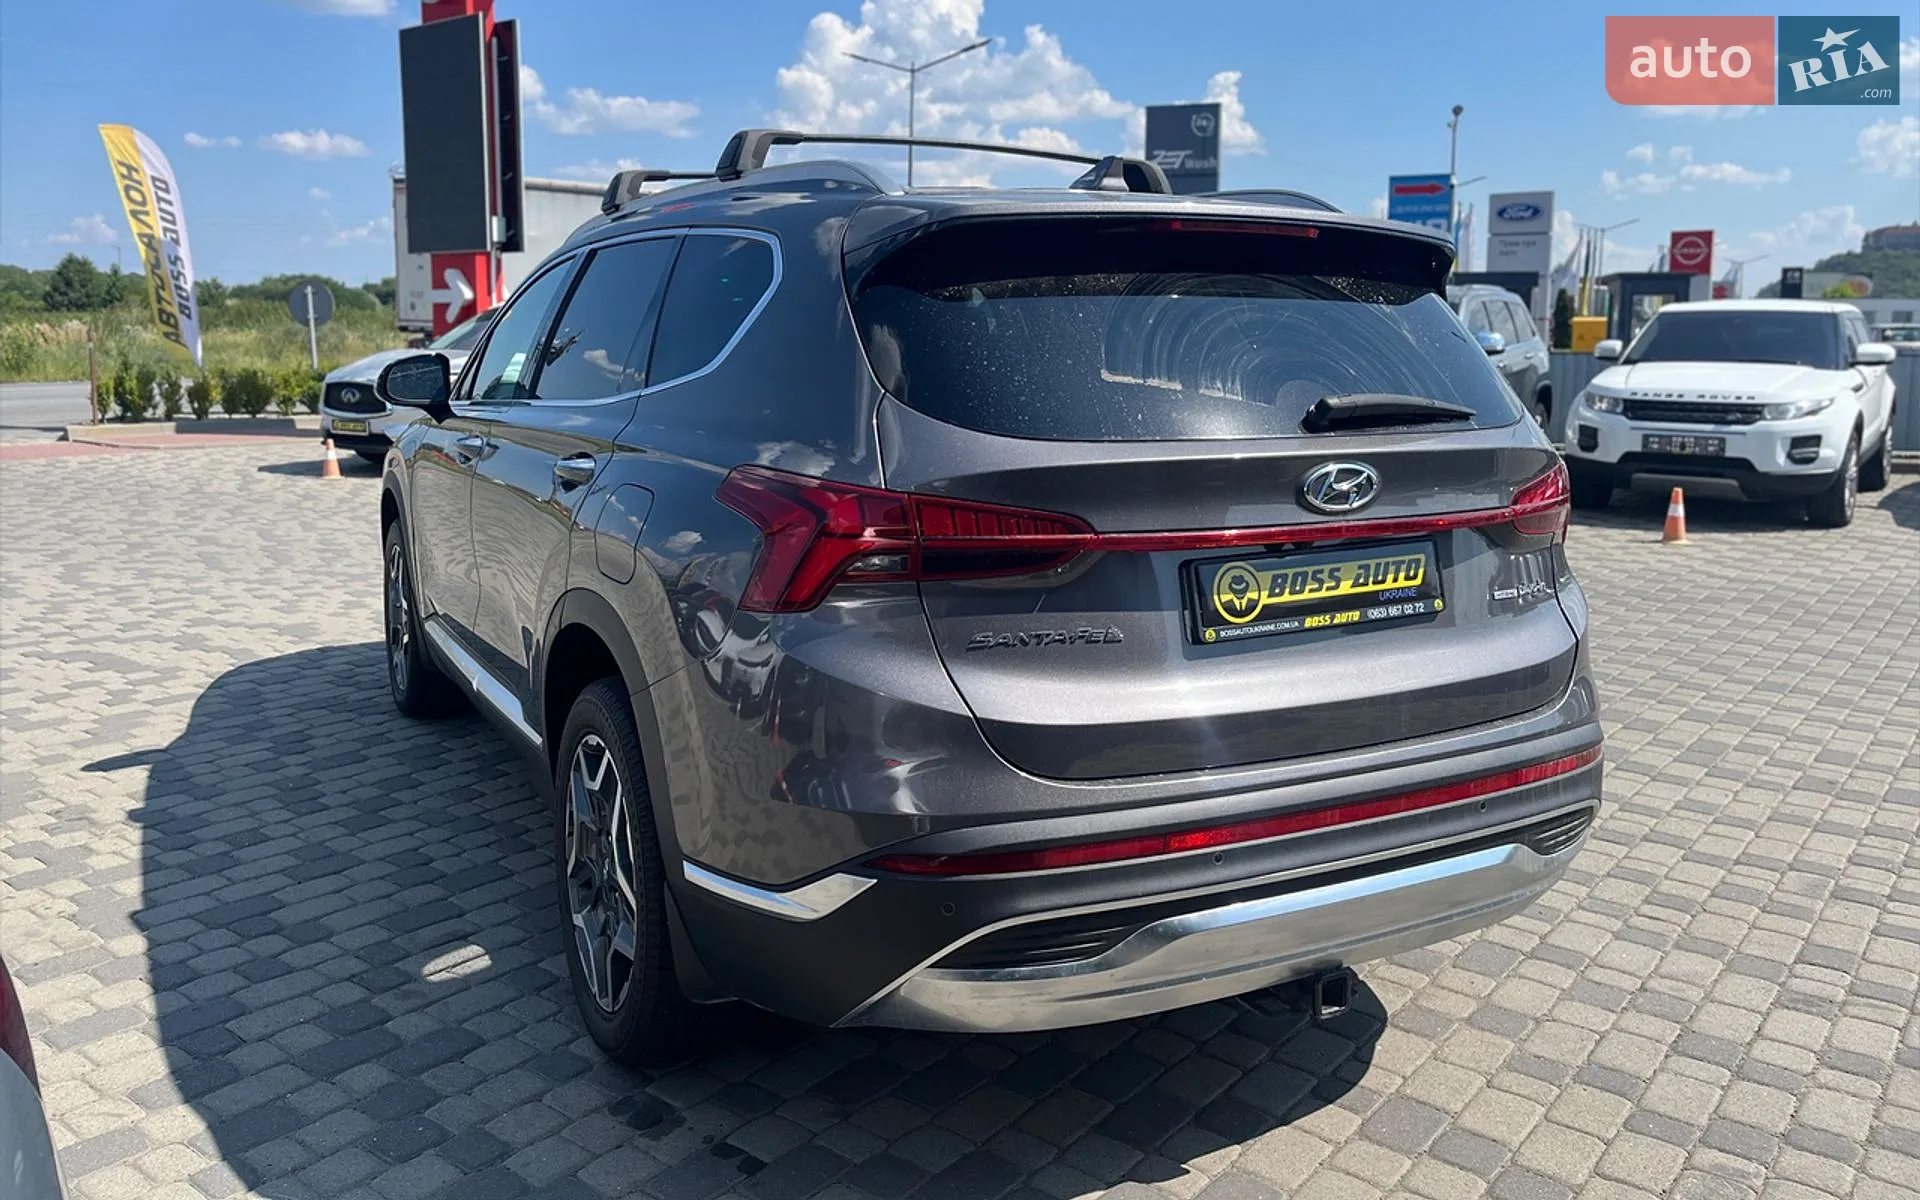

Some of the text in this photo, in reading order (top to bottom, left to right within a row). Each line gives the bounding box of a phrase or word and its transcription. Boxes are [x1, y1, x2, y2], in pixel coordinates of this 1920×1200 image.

[117, 160, 189, 349] АВТОСАЛОН
[150, 175, 194, 321] BOSS AUTO
[1630, 391, 1756, 401] RANGE ROVER
[1267, 557, 1422, 599] BOSS AUTO
[1378, 586, 1418, 601] UKRAINE
[1415, 602, 1425, 613] 72
[1304, 610, 1361, 628] BOSS AUTO
